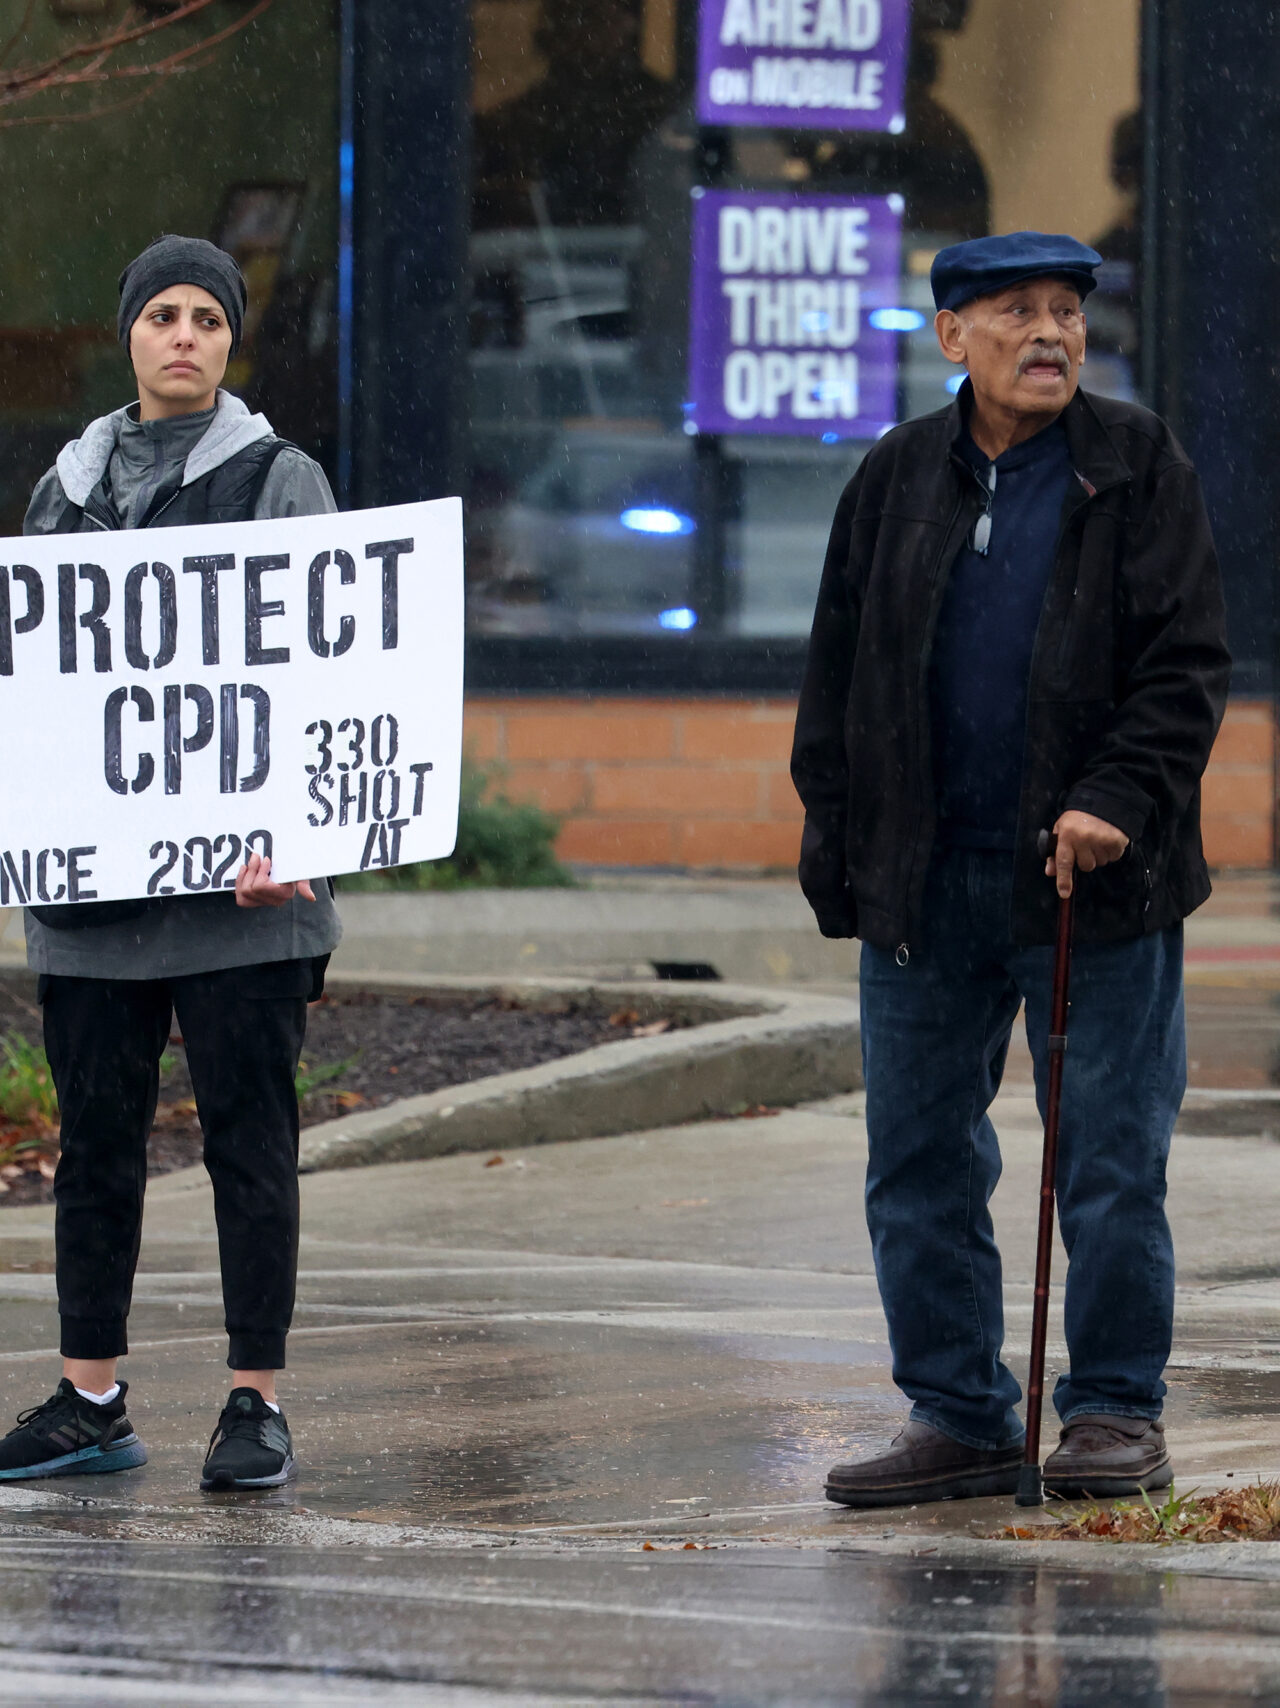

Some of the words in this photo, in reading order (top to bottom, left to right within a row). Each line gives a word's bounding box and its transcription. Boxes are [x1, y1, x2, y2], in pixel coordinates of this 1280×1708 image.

[721, 0, 882, 51] AHEAD
[752, 55, 885, 109] MOBILE
[719, 206, 870, 275] DRIVE
[723, 279, 860, 347] THRU
[724, 351, 859, 420] OPEN
[104, 683, 271, 795] CPD
[304, 713, 399, 775] 330
[307, 763, 433, 827] SHOT
[359, 818, 410, 871] AT
